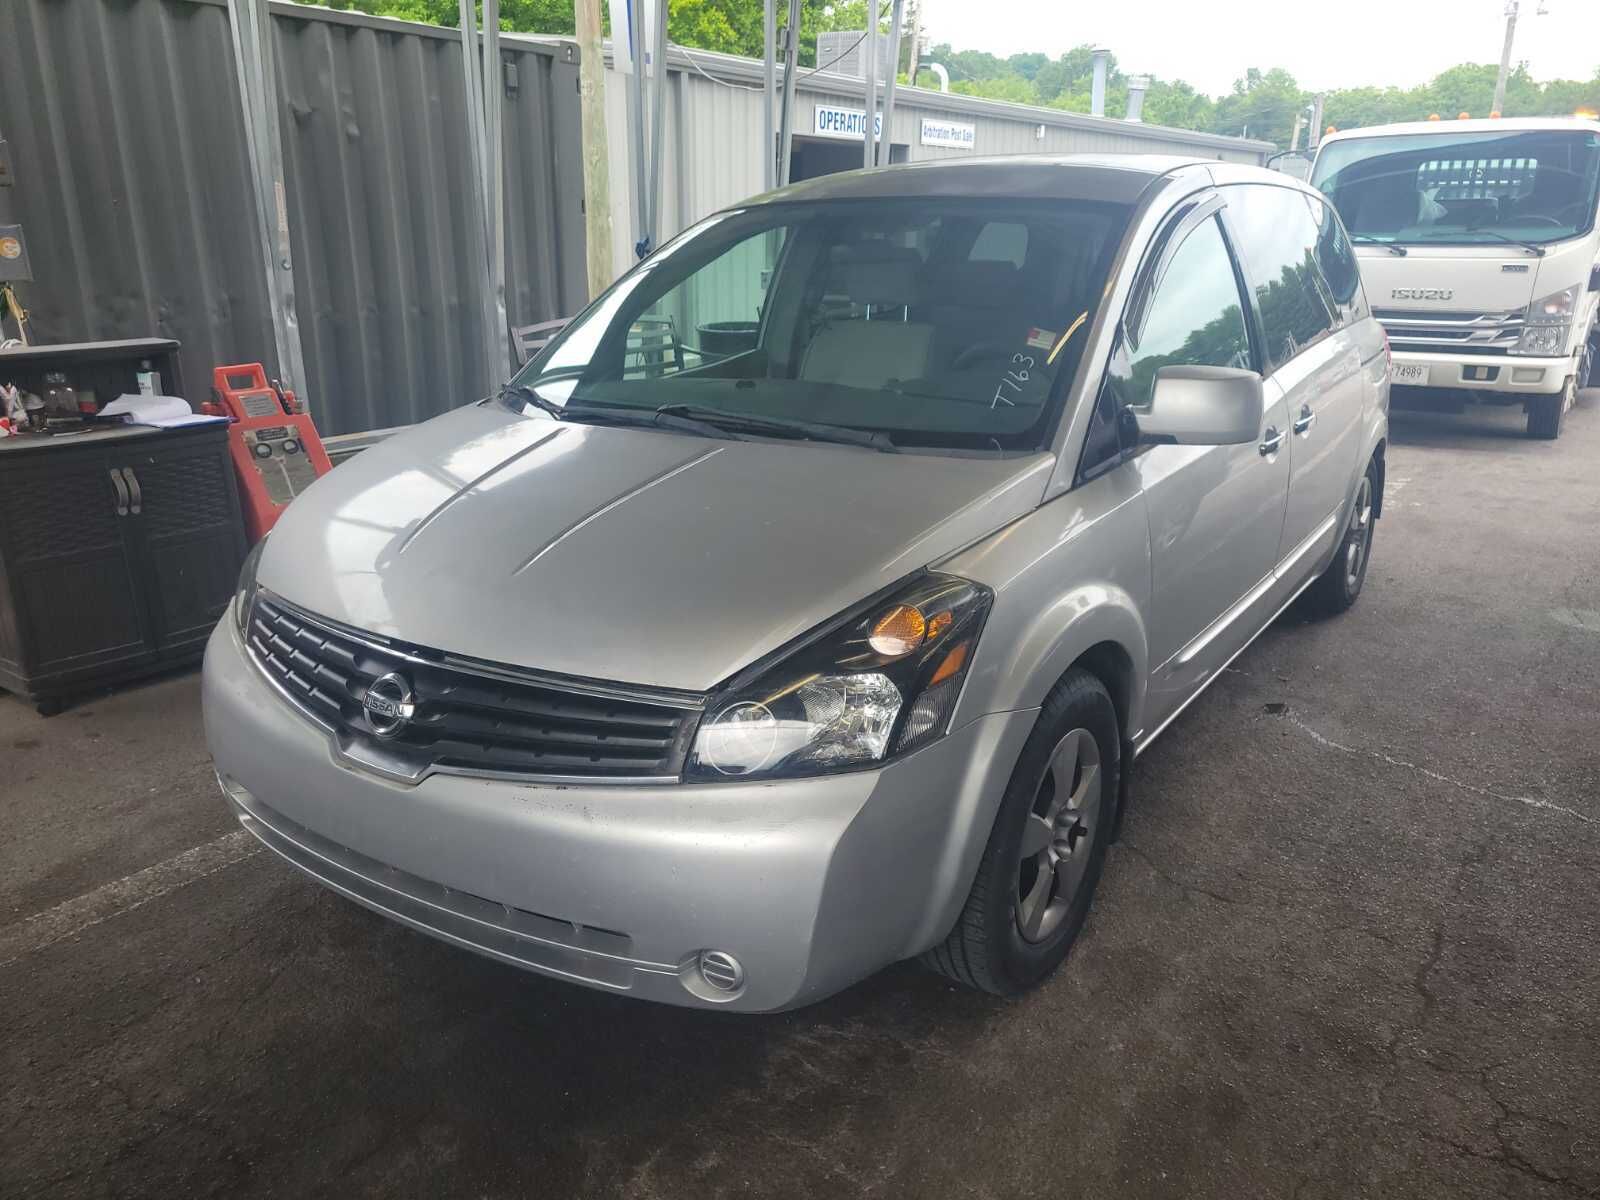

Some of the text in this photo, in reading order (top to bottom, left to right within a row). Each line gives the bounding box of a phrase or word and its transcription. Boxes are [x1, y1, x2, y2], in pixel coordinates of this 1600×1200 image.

[819, 110, 881, 135] OPERATIOS
[1391, 288, 1454, 301] ISUZU
[990, 352, 1035, 410] T163
[1391, 367, 1422, 377] 74989
[362, 694, 404, 718] NISSAN
